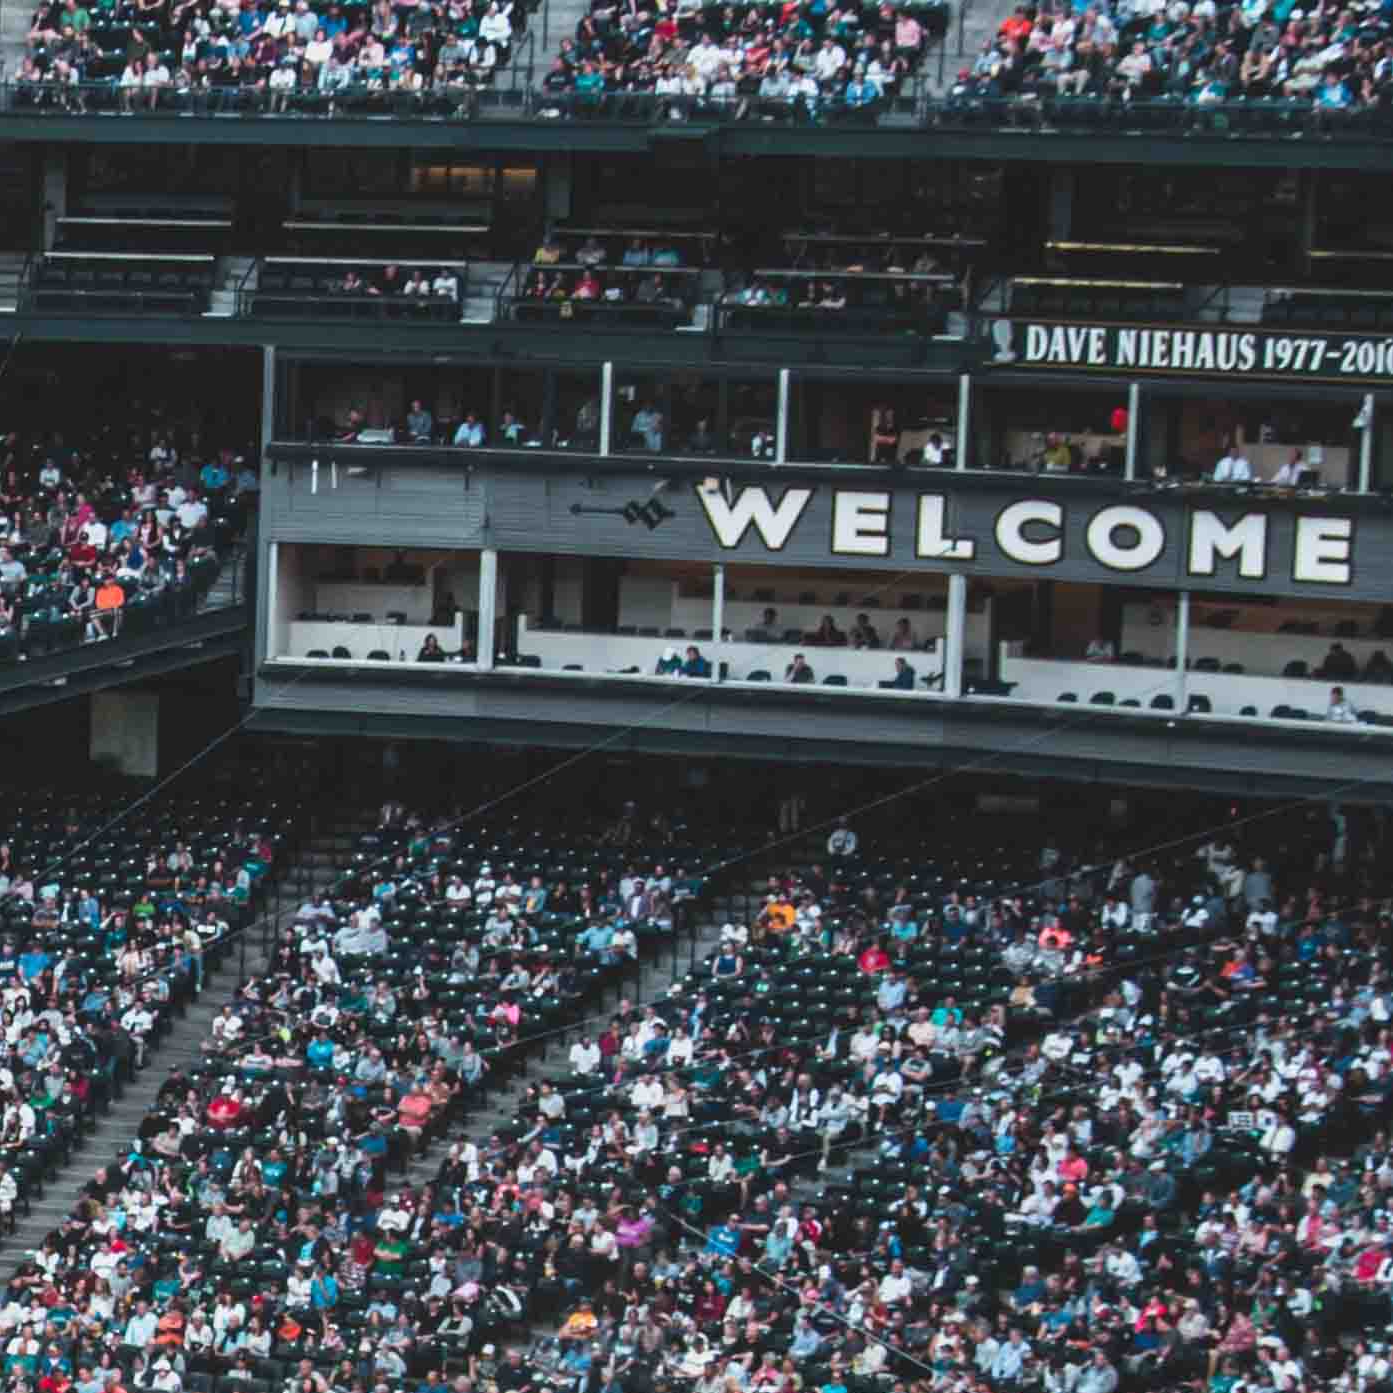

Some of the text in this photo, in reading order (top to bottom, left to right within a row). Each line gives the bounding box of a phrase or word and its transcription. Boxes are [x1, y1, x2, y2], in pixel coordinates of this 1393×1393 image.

[1025, 324, 1107, 364] DAVE
[1115, 329, 1257, 372] NIEHAUS
[697, 482, 1354, 584] WELCOME
